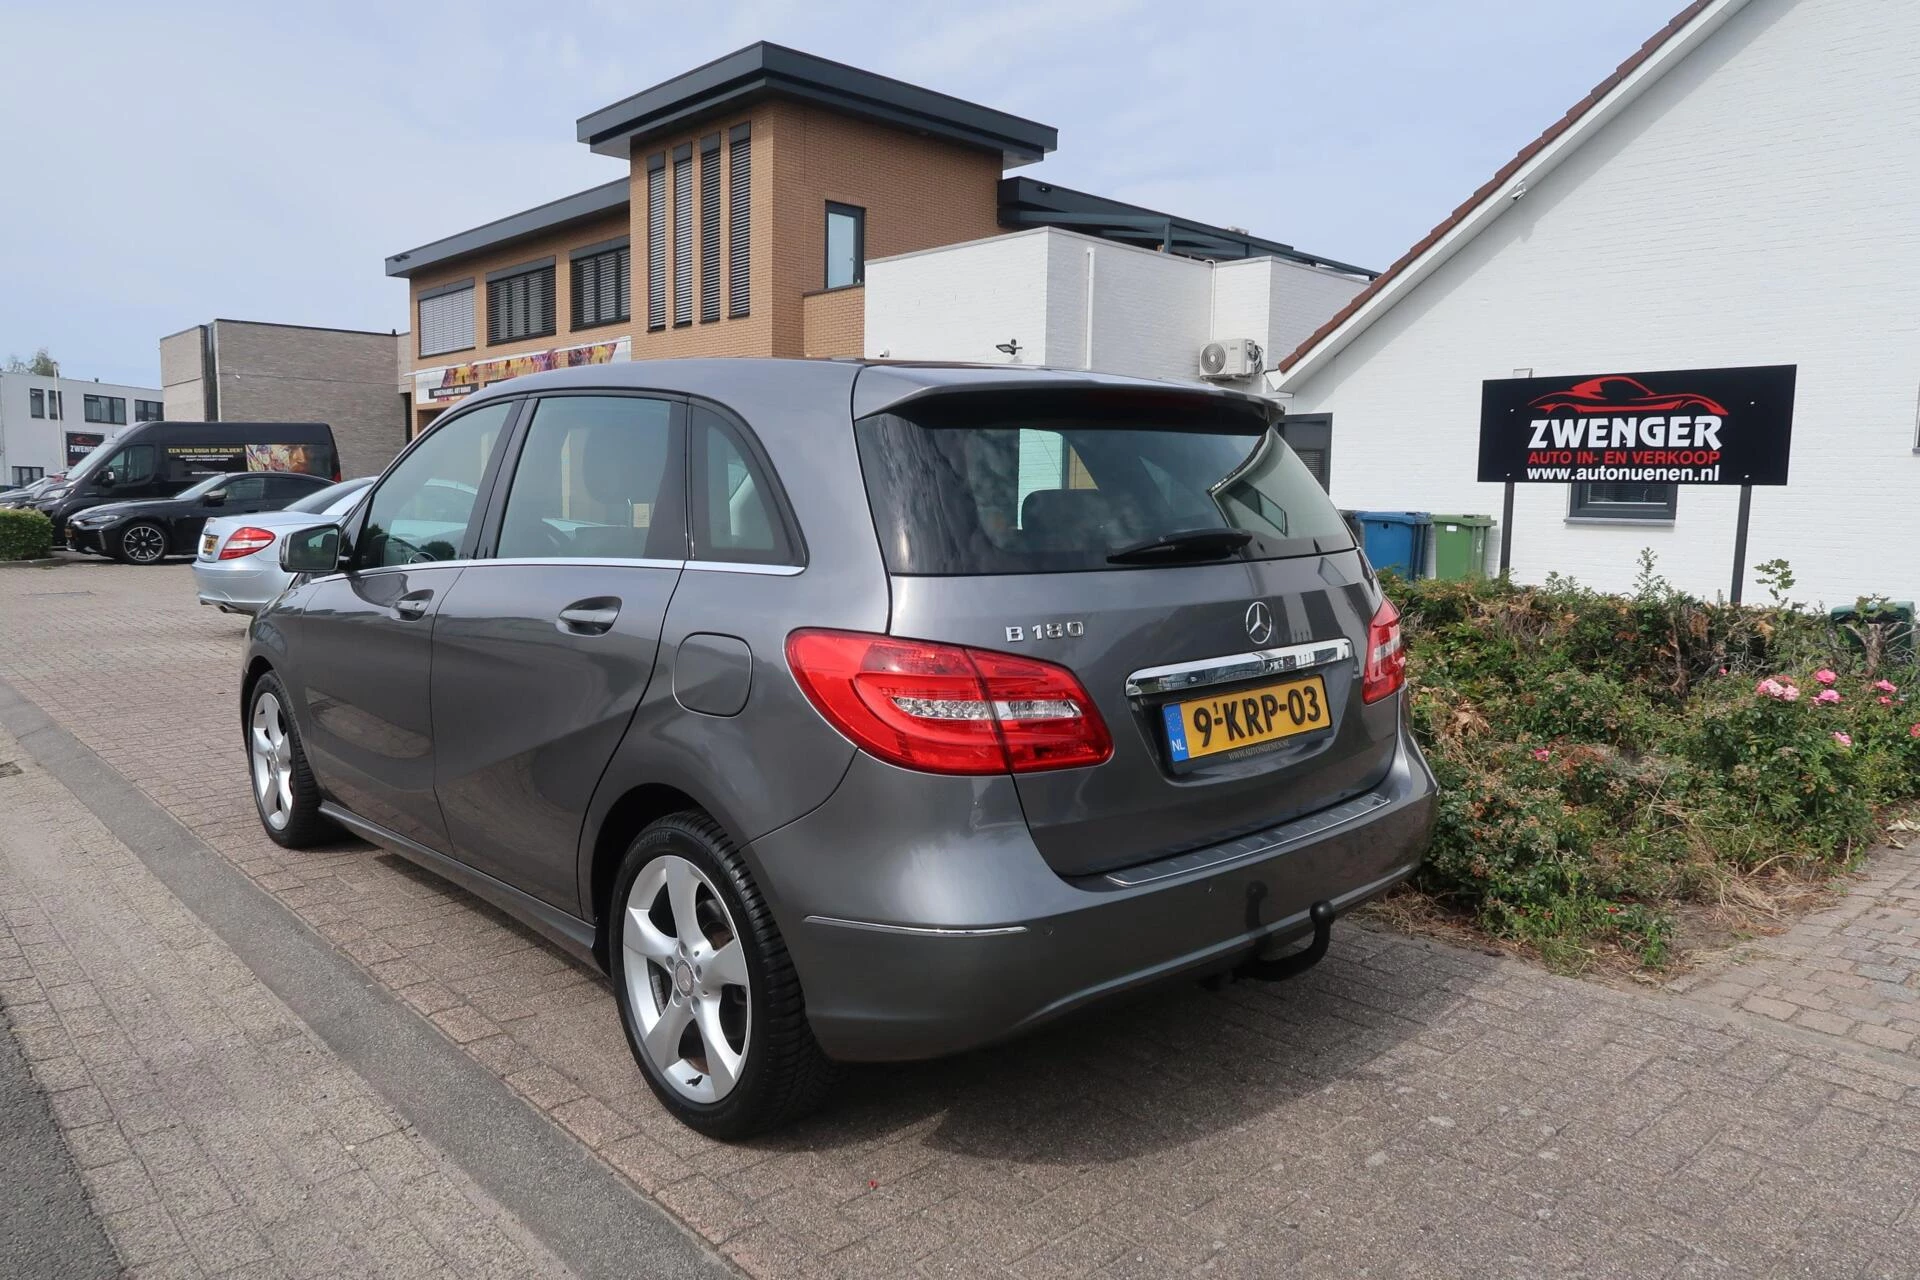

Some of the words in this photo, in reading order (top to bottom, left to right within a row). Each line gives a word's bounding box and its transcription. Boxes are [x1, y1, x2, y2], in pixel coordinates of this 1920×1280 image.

[1528, 415, 1723, 450] ZWENGER
[70, 445, 98, 453] ZWENG
[1528, 451, 1572, 465] AUTO
[1577, 451, 1599, 464] IN-
[1604, 451, 1627, 464] EN
[1632, 451, 1720, 464] VERKOOP
[1527, 465, 1720, 481] www.autonuenen.nl
[1005, 626, 1024, 642] B
[1032, 621, 1084, 640] 180
[1193, 686, 1321, 747] 9-KRP-03
[1172, 740, 1185, 752] NL
